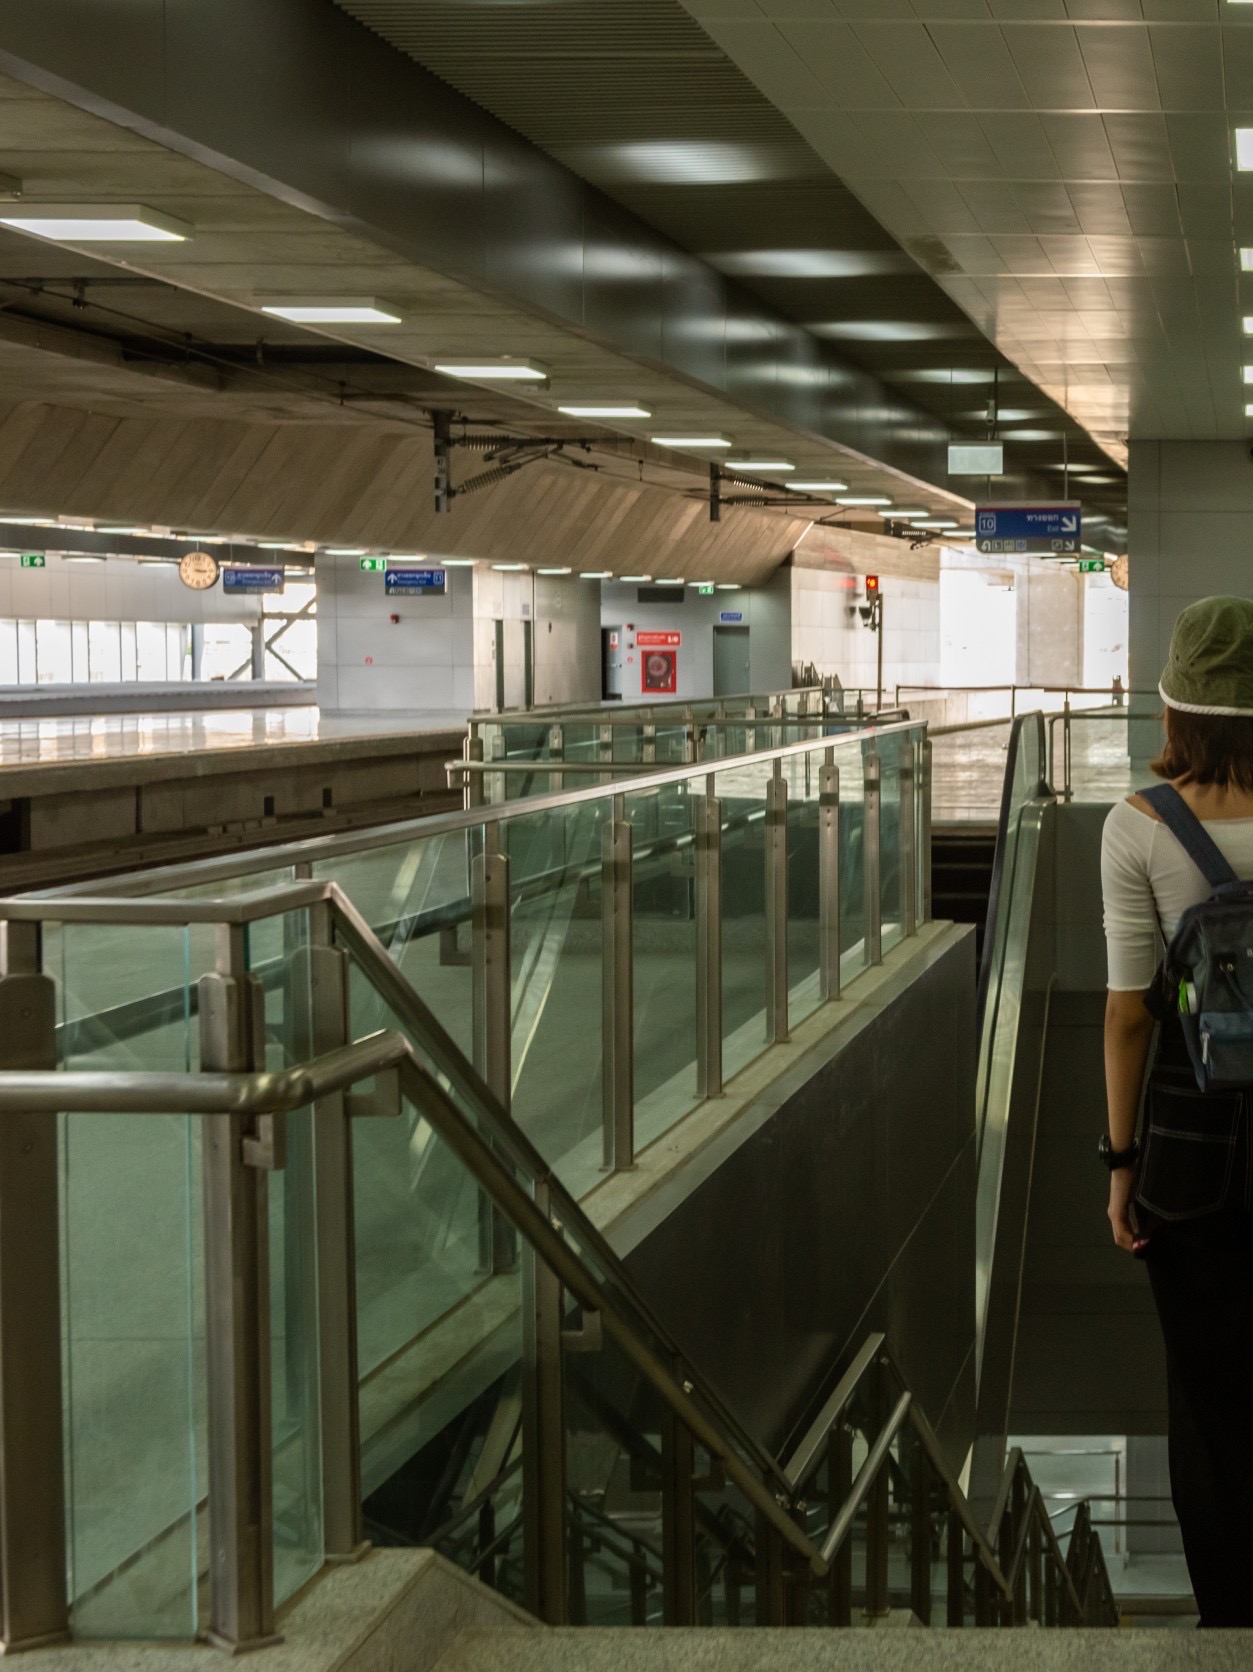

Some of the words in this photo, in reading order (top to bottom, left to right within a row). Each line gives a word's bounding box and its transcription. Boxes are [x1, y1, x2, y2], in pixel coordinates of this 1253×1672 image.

[1026, 513, 1059, 522] ทางออก
[981, 519, 994, 530] 10
[1047, 524, 1060, 533] Exit
